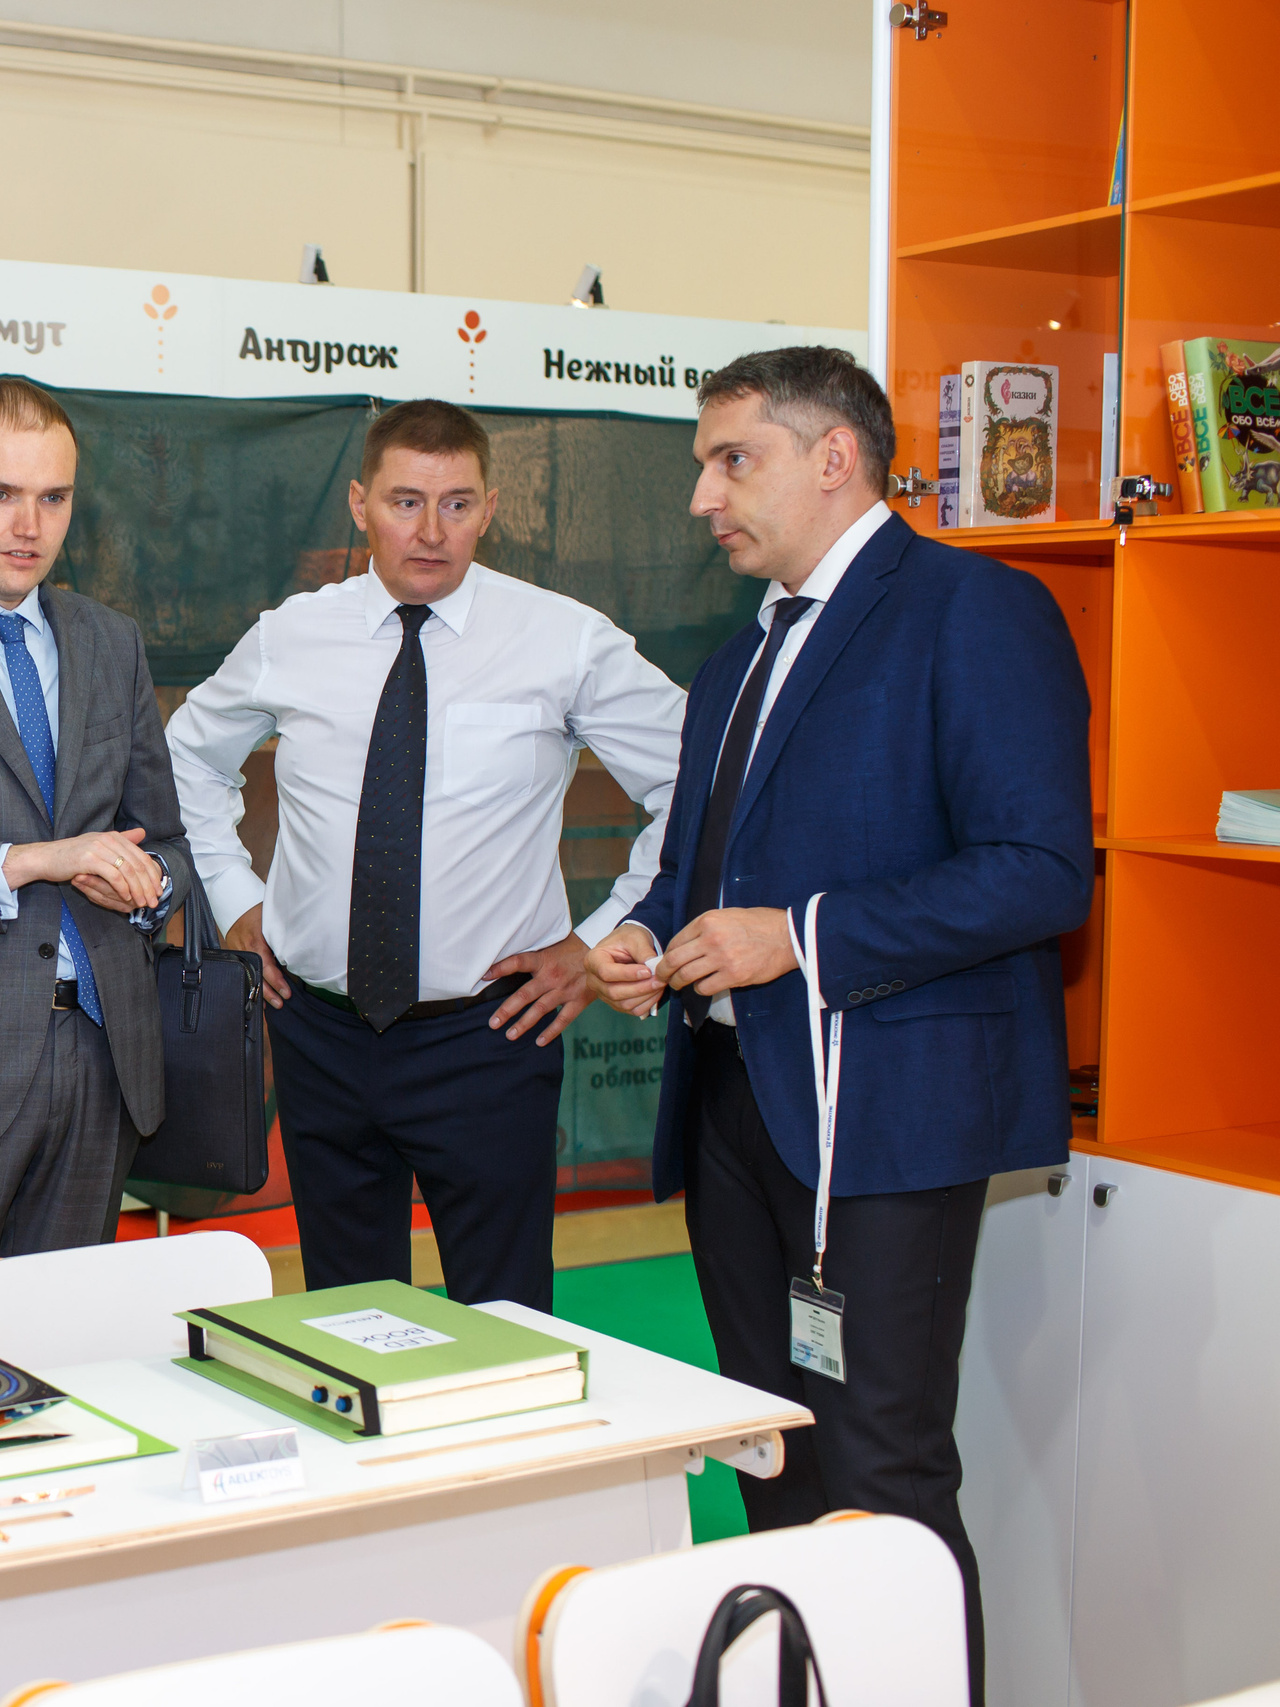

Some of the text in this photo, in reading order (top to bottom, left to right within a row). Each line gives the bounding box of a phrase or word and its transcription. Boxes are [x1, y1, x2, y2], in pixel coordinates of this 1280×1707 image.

[239, 327, 399, 373] Антураж
[543, 348, 675, 388] Нежный
[1168, 374, 1179, 401] ОБО
[1232, 414, 1253, 426] ОБО
[353, 1327, 426, 1344] BOOK
[384, 1336, 434, 1349] LED
